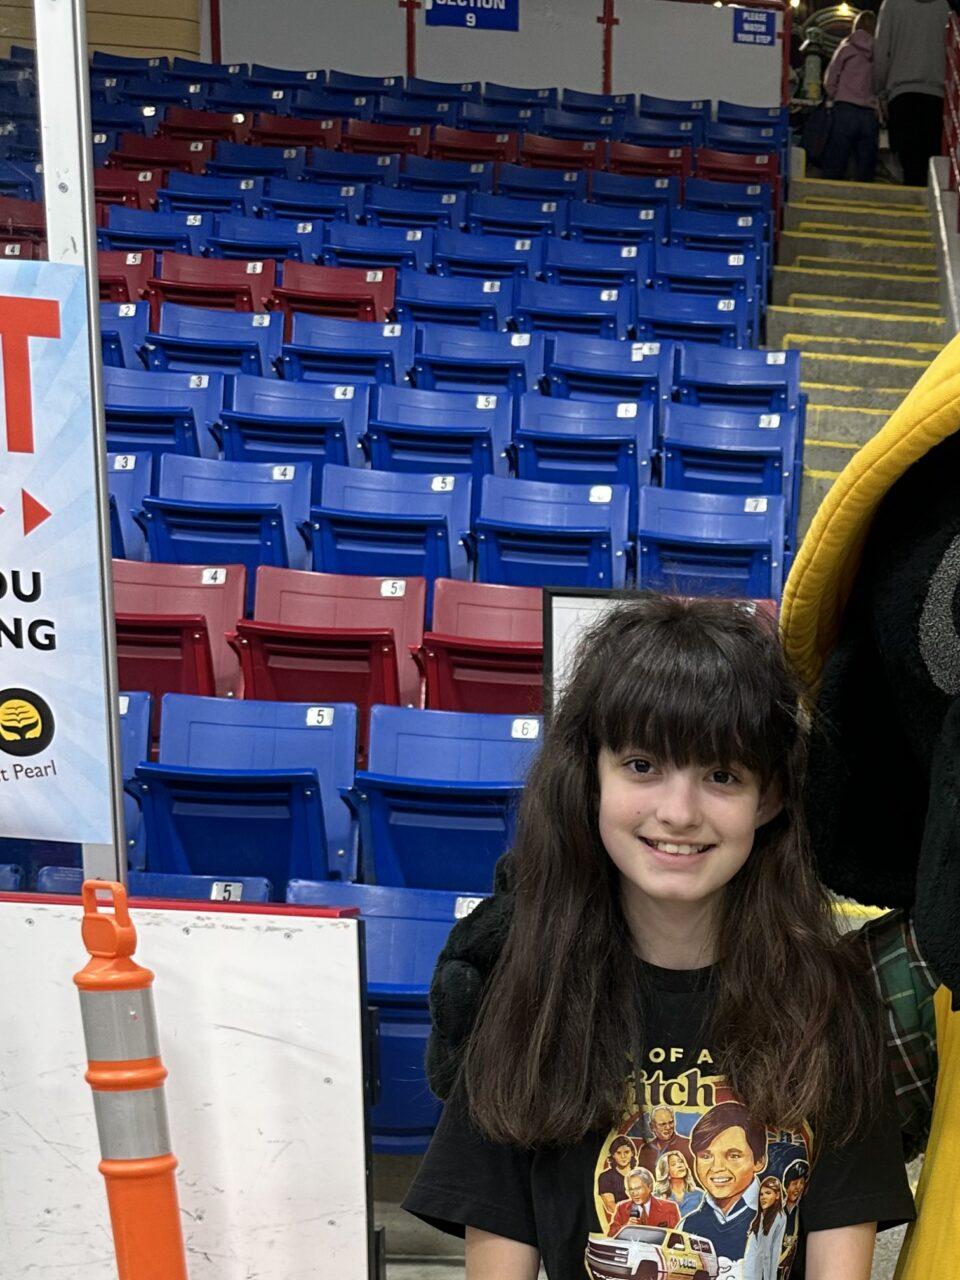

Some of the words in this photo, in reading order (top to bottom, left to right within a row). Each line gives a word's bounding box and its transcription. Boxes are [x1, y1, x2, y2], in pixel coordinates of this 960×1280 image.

[436, 0, 505, 10] SECTION
[466, 13, 477, 27] 9
[131, 254, 137, 264] 5
[252, 263, 257, 273] 6
[124, 305, 131, 316] 2
[0, 295, 61, 454] T
[195, 376, 203, 387] 3
[341, 386, 348, 398] 4
[484, 397, 491, 408] 5
[121, 456, 129, 469] 3
[280, 467, 288, 479] 4
[440, 477, 448, 490] 5
[753, 499, 760, 511] 7
[210, 570, 218, 583] 4
[0, 570, 42, 603] U
[390, 581, 398, 595] 5
[316, 709, 325, 725] 5
[521, 720, 531, 735] 6
[13, 759, 57, 780] Pearl
[222, 883, 232, 901] 5
[649, 1047, 684, 1063] OF
[697, 1048, 714, 1065] A
[632, 1068, 716, 1107] itch
